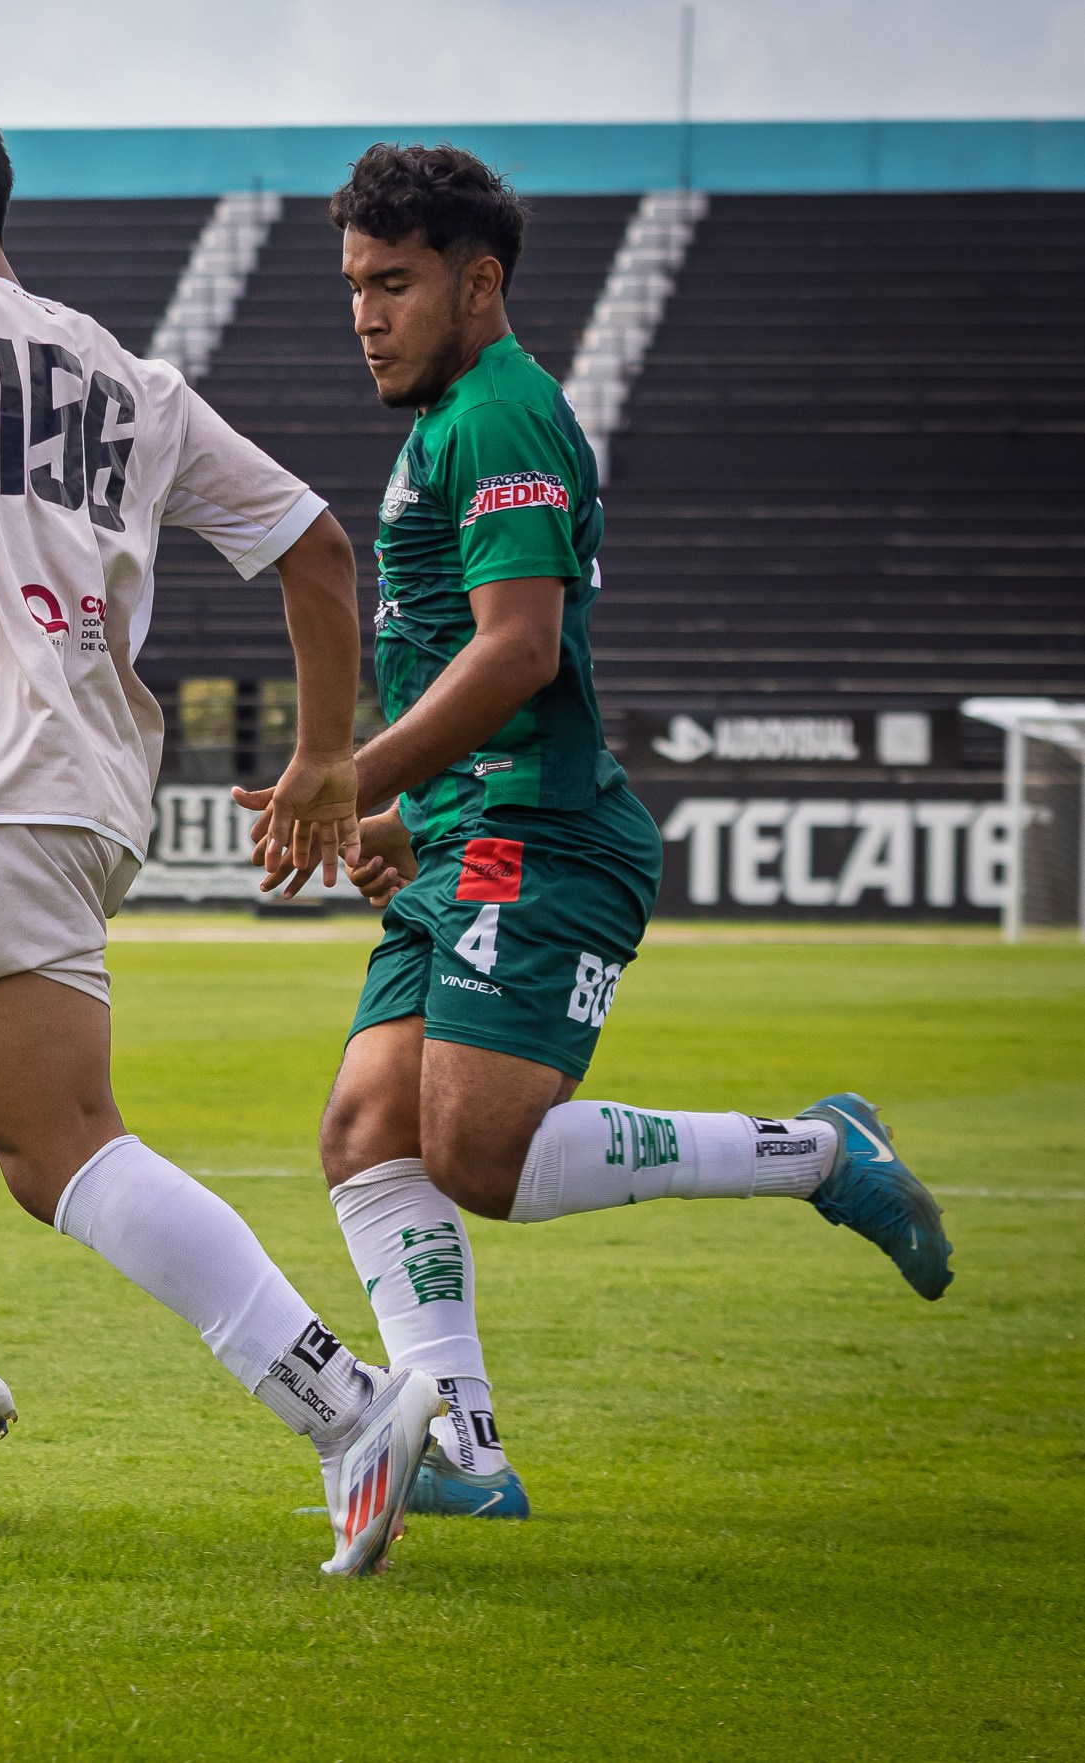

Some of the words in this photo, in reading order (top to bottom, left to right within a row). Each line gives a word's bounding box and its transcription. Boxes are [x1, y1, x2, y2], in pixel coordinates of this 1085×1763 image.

[81, 643, 95, 651] DE
[82, 631, 102, 639] DEL
[662, 799, 1028, 908] TECATE
[454, 904, 500, 976] 4
[441, 975, 503, 996] VINDEX
[301, 1387, 337, 1423] SOCKS
